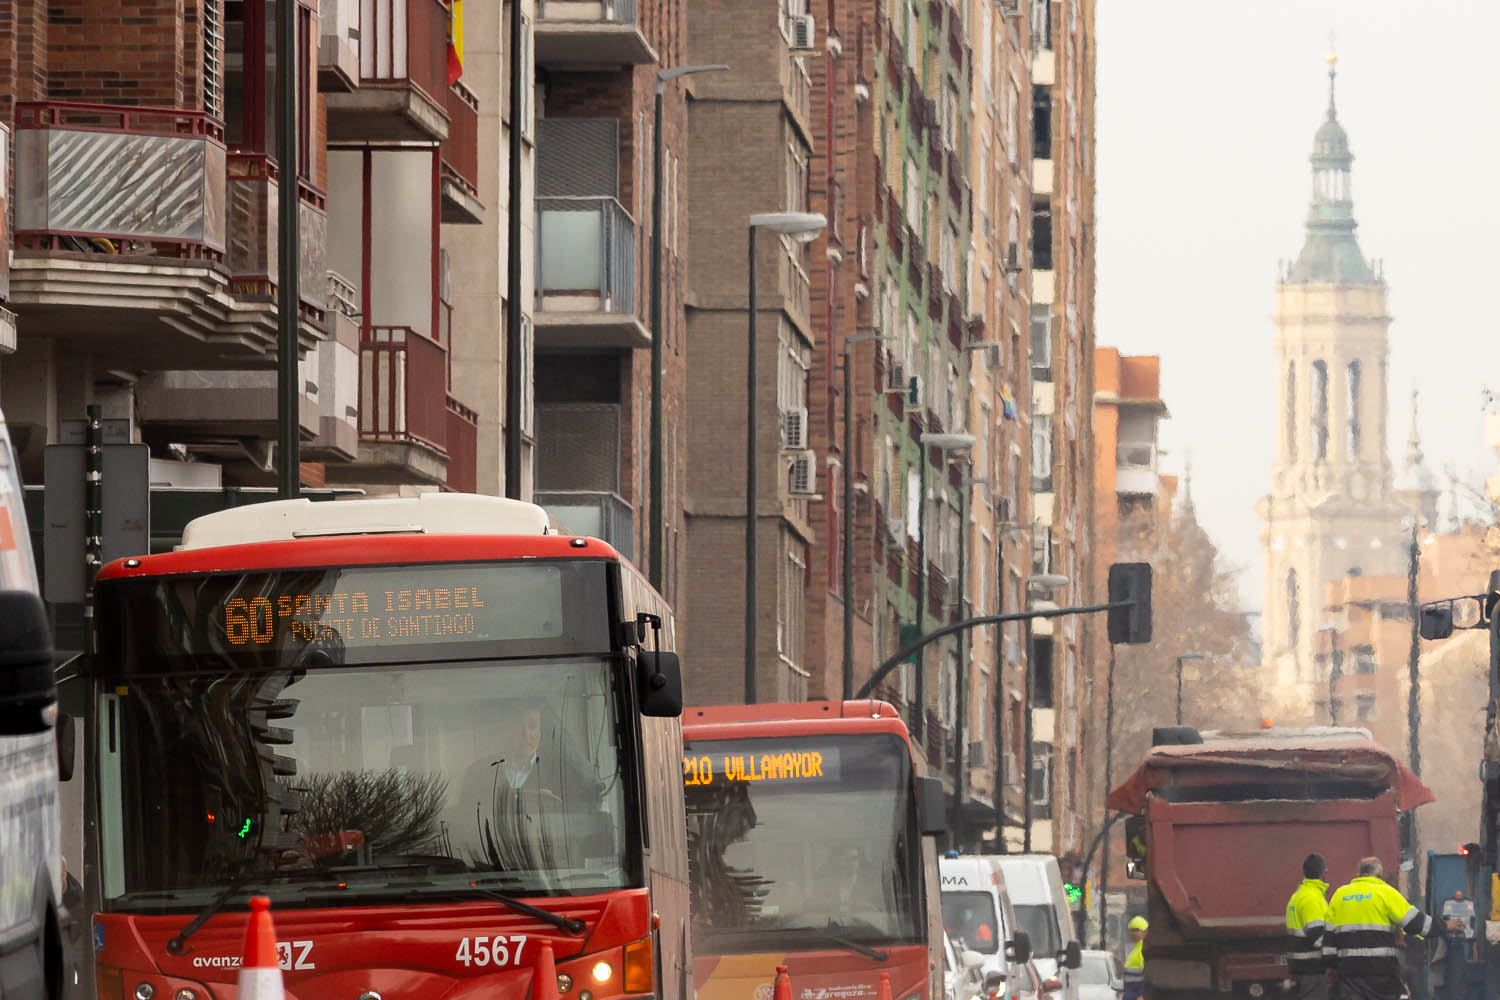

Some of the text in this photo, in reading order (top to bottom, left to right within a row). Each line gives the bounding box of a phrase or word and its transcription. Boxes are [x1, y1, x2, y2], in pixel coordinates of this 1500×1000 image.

[226, 587, 485, 644] 60 SANTA ISABEL
[292, 612, 475, 641] PUENTE DE SANTIAGO
[723, 752, 823, 781] VILLAMAYOR
[455, 935, 527, 967] 4567
